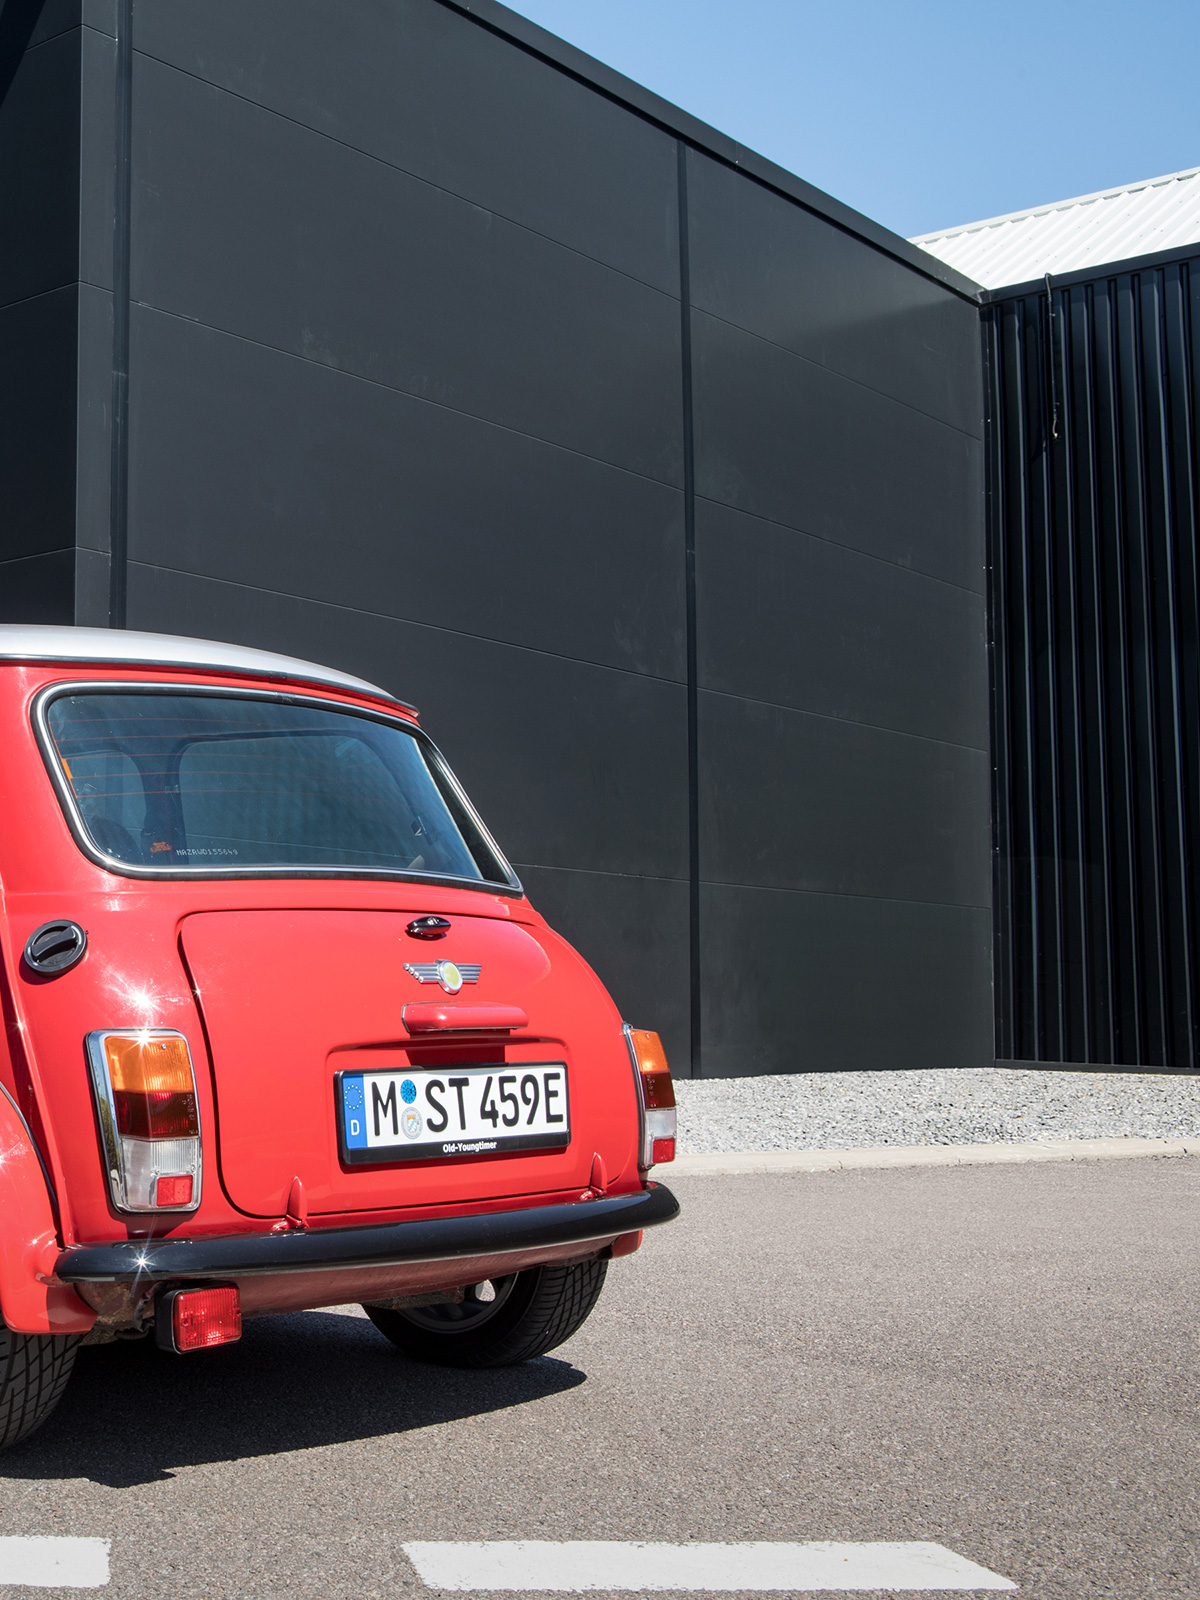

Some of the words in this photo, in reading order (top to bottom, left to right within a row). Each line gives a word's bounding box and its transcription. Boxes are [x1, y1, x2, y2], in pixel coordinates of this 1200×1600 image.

[371, 1080, 399, 1137] M
[425, 1077, 470, 1133] ST
[480, 1072, 564, 1129] 459E
[350, 1119, 361, 1136] D
[442, 1140, 498, 1153] Old-Youngtimer
